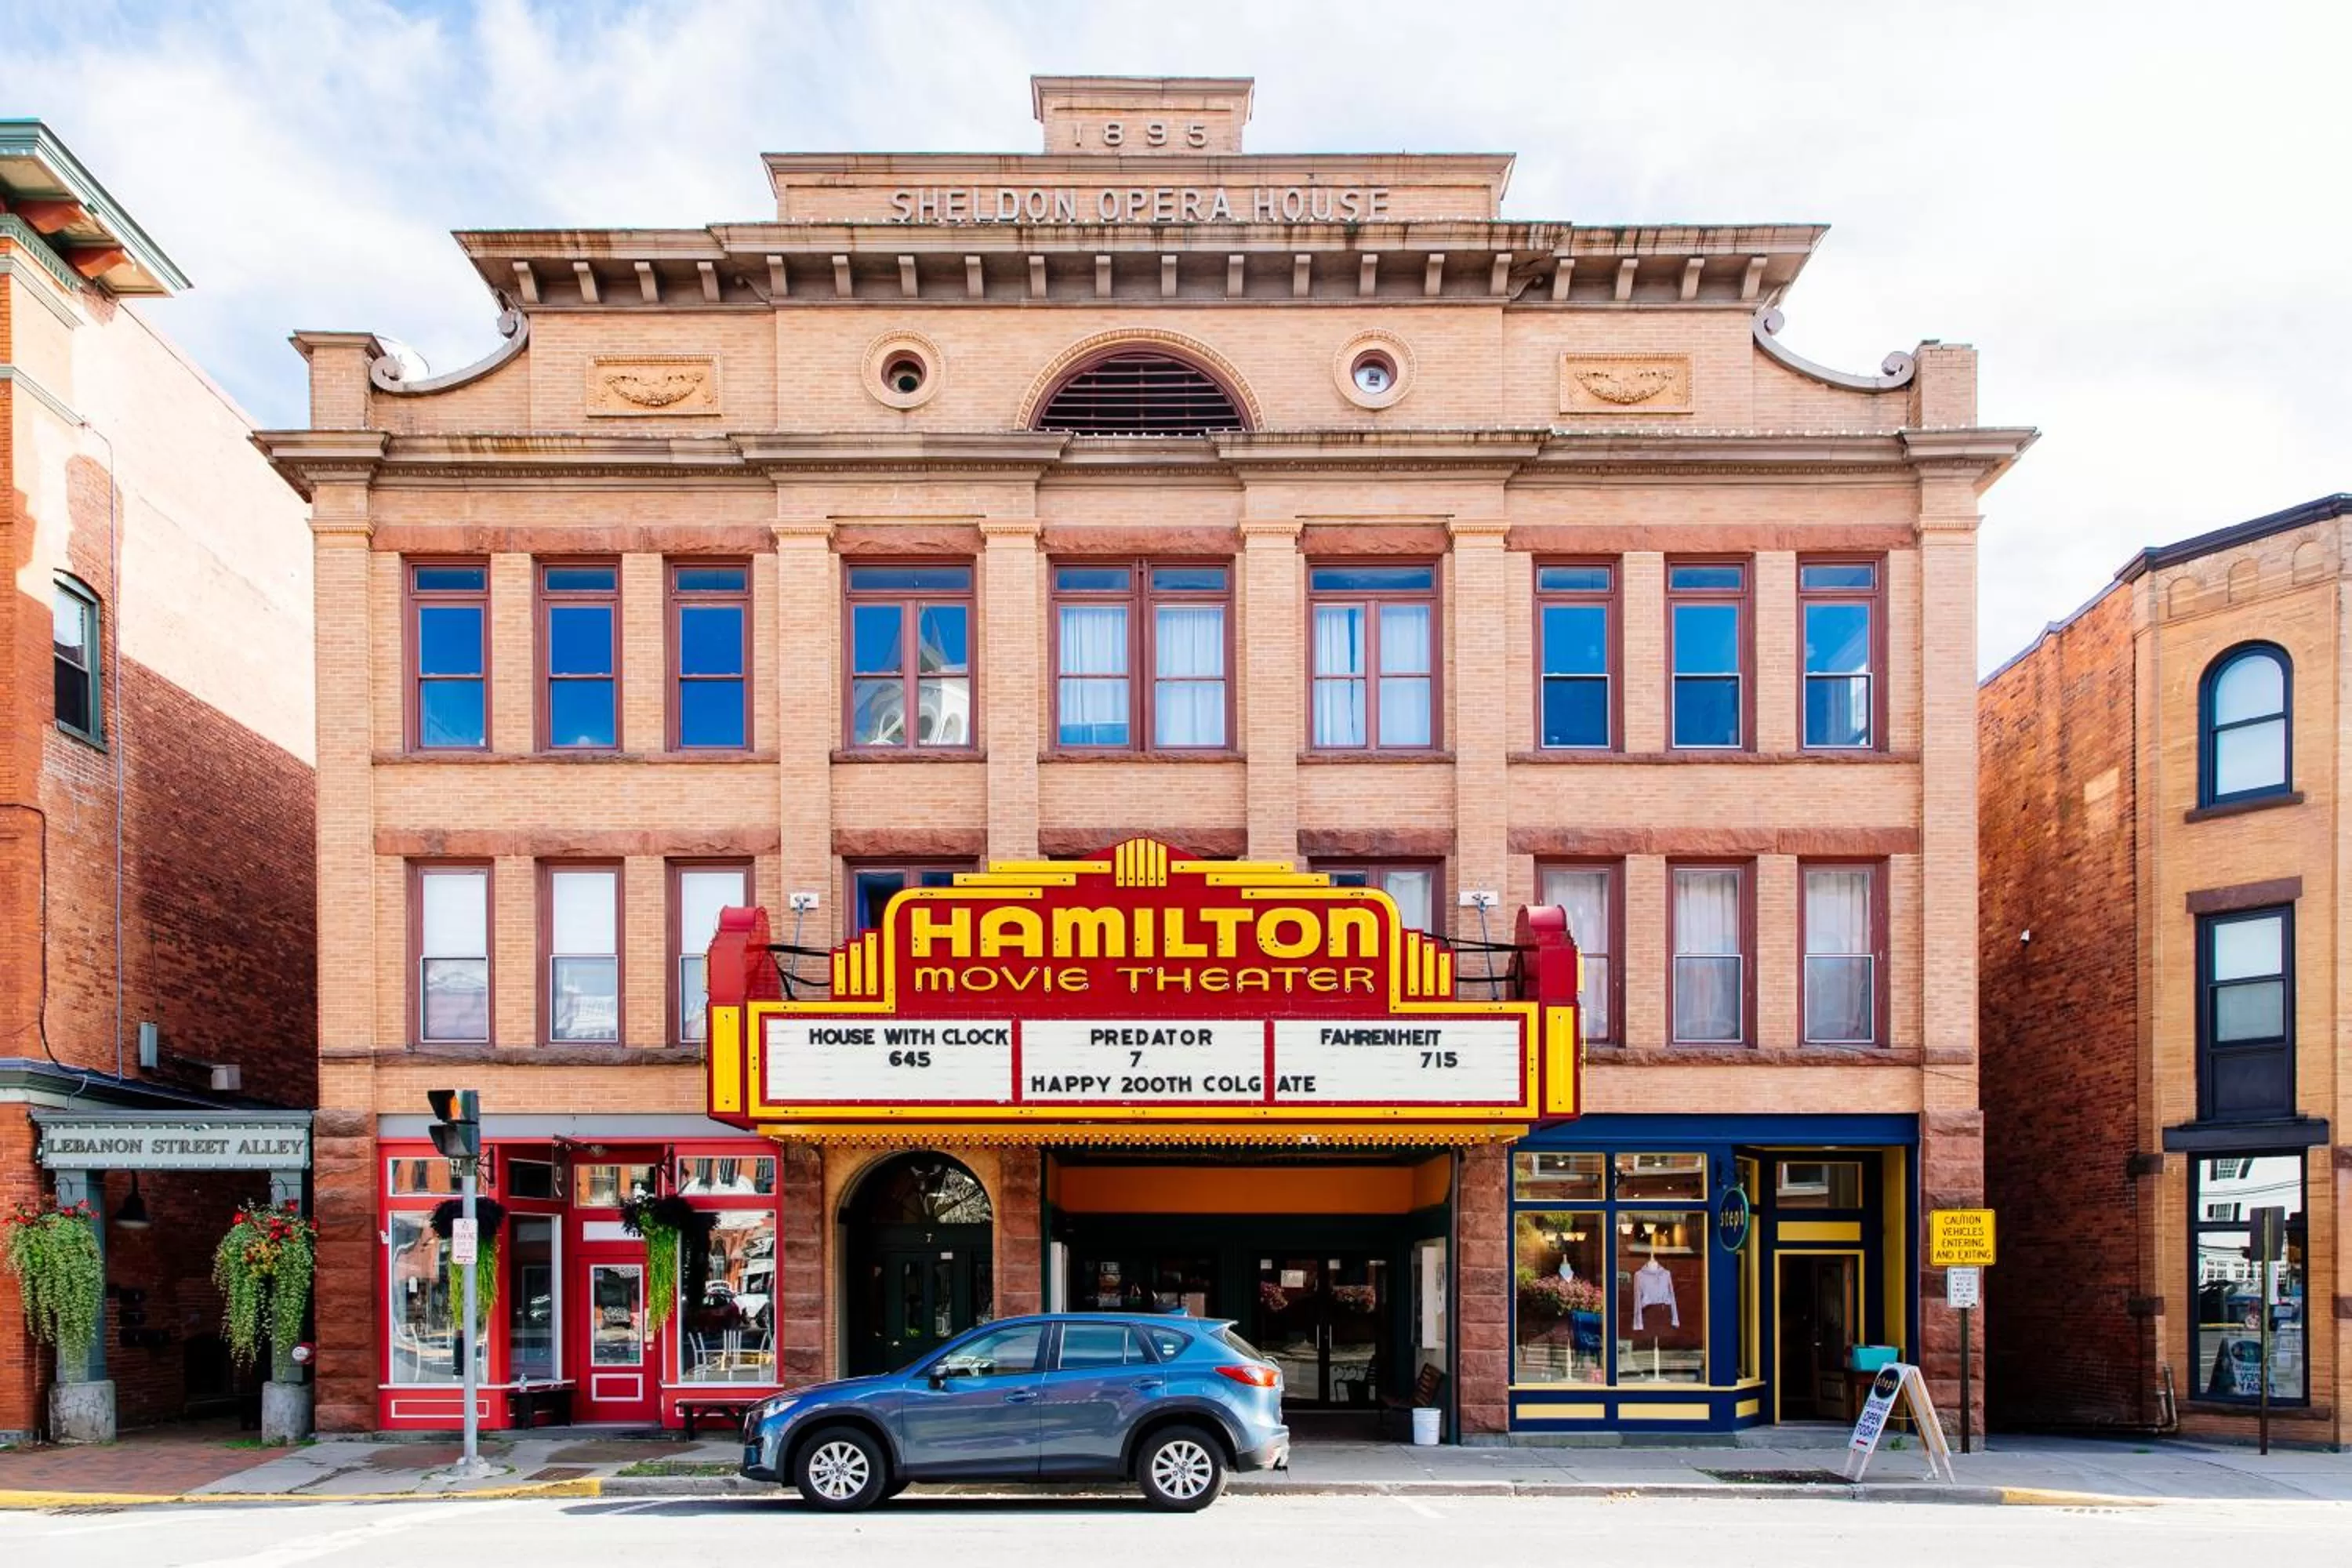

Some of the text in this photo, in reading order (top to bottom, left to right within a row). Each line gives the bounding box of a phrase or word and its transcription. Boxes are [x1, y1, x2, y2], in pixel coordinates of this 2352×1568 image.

[1073, 122, 1207, 147] 1895
[891, 187, 1389, 223] SHELDON OPERA HOUSE
[910, 906, 1379, 958] HAMILTON
[915, 967, 1376, 993] MOVIE THEATER
[809, 1028, 1008, 1046] HOUSE WITH CLOCK
[1091, 1029, 1212, 1046] PREDATOR
[1320, 1028, 1442, 1046] FAHRENHEIT
[888, 1051, 931, 1068] 645
[1130, 1051, 1142, 1067] 7
[1421, 1051, 1457, 1069] 715
[1031, 1076, 1111, 1092] HAPPY
[1121, 1076, 1192, 1093] 200TH
[48, 1138, 305, 1155] LEBANON STREET ALLEY
[1944, 1215, 1981, 1225] CAUTION
[1942, 1227, 1984, 1236] VEHICLES
[1942, 1238, 1984, 1248] ENTERING
[1936, 1250, 1991, 1260] AND EXITING
